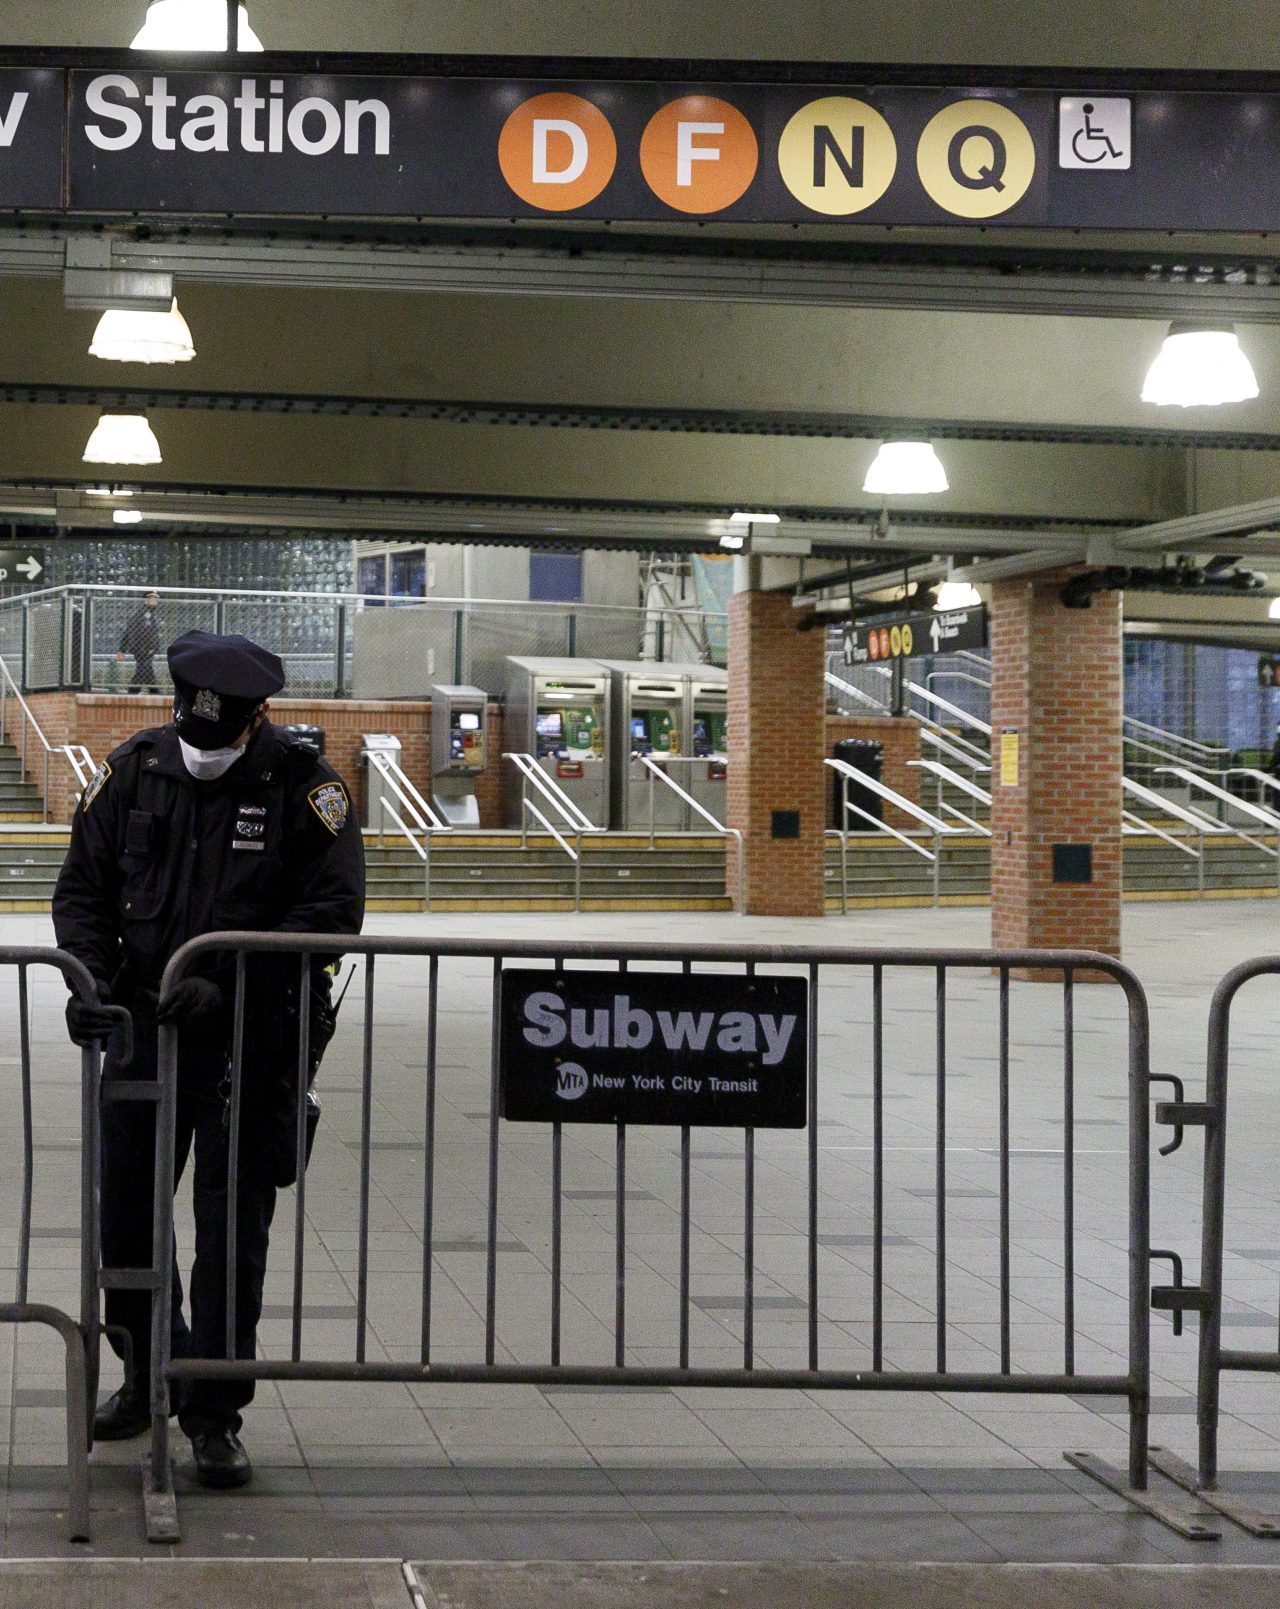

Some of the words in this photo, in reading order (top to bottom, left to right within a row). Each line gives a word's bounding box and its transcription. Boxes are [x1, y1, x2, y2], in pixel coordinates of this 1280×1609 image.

[83, 77, 391, 156] Station
[532, 119, 589, 184] D
[676, 122, 725, 186] F
[812, 124, 866, 188] N
[947, 124, 1007, 193] Q
[314, 791, 343, 807] DEPARTMENT
[317, 786, 336, 797] POLICE
[522, 991, 797, 1065] Subway
[592, 1073, 626, 1089] New
[631, 1074, 665, 1090] York
[671, 1075, 702, 1093] City
[708, 1077, 758, 1092] Transit
